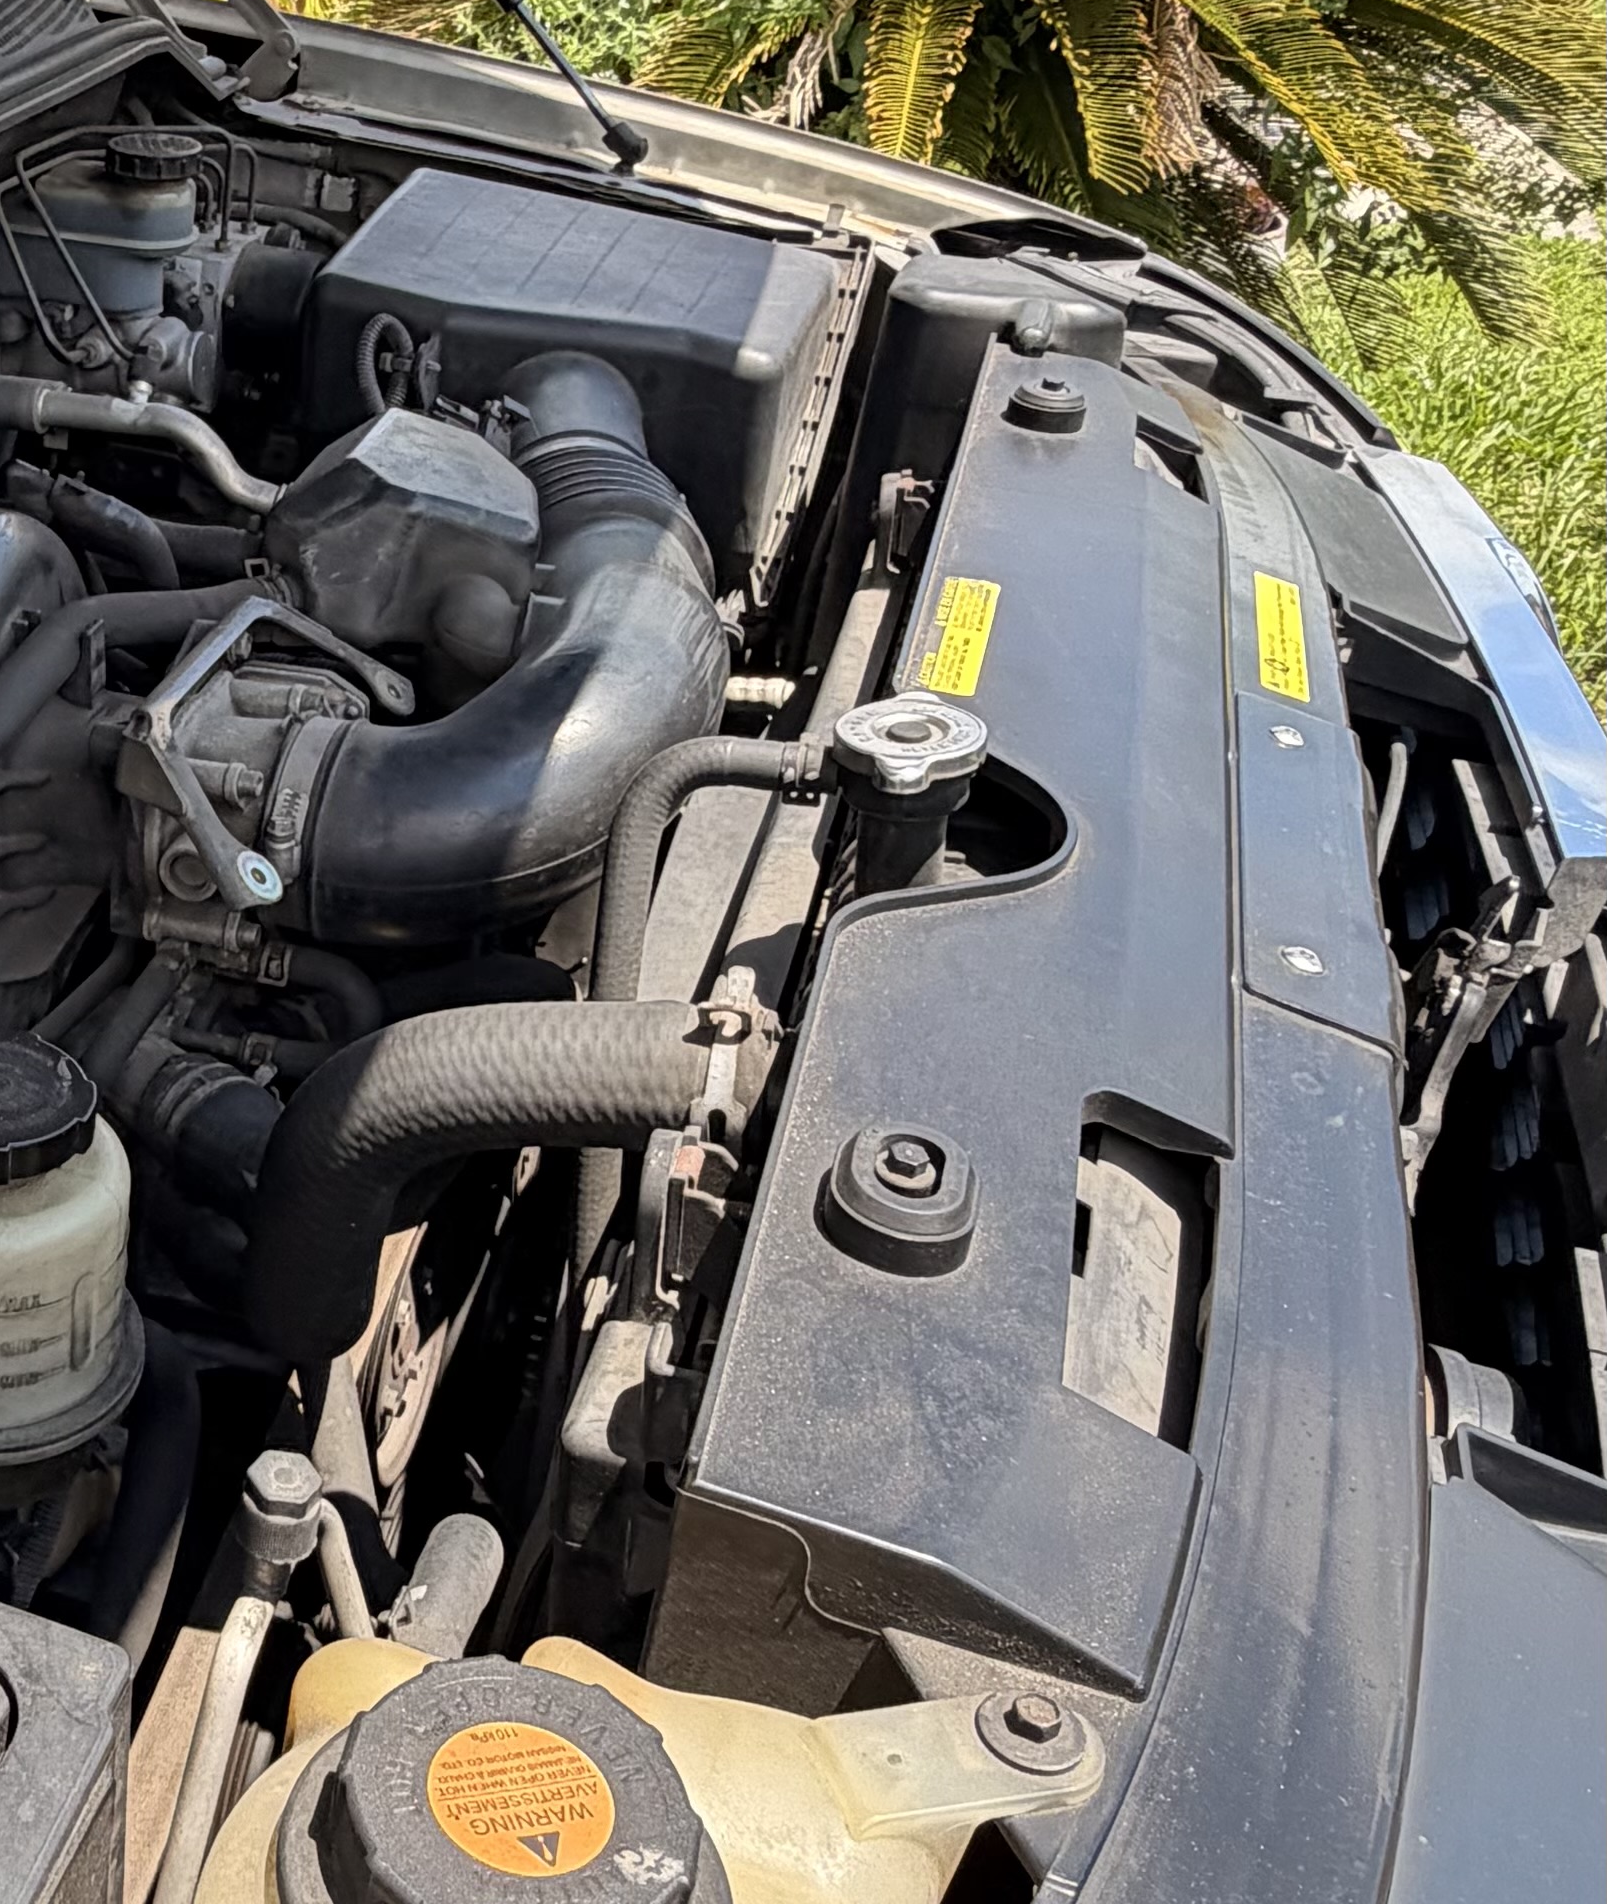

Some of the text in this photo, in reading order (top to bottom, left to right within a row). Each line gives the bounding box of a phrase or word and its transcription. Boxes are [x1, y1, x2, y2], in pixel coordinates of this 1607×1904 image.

[485, 1751, 525, 1767] MOTOR
[525, 1744, 567, 1760] NISSAN
[566, 1754, 582, 1766] NE
[528, 1757, 566, 1772] JAMAIS
[548, 1763, 592, 1781] NEVER
[469, 1779, 507, 1793] WHEN
[509, 1772, 545, 1787] OPEN
[445, 1780, 599, 1819] AVERTISSEMENT
[469, 1801, 594, 1836] WARNING
